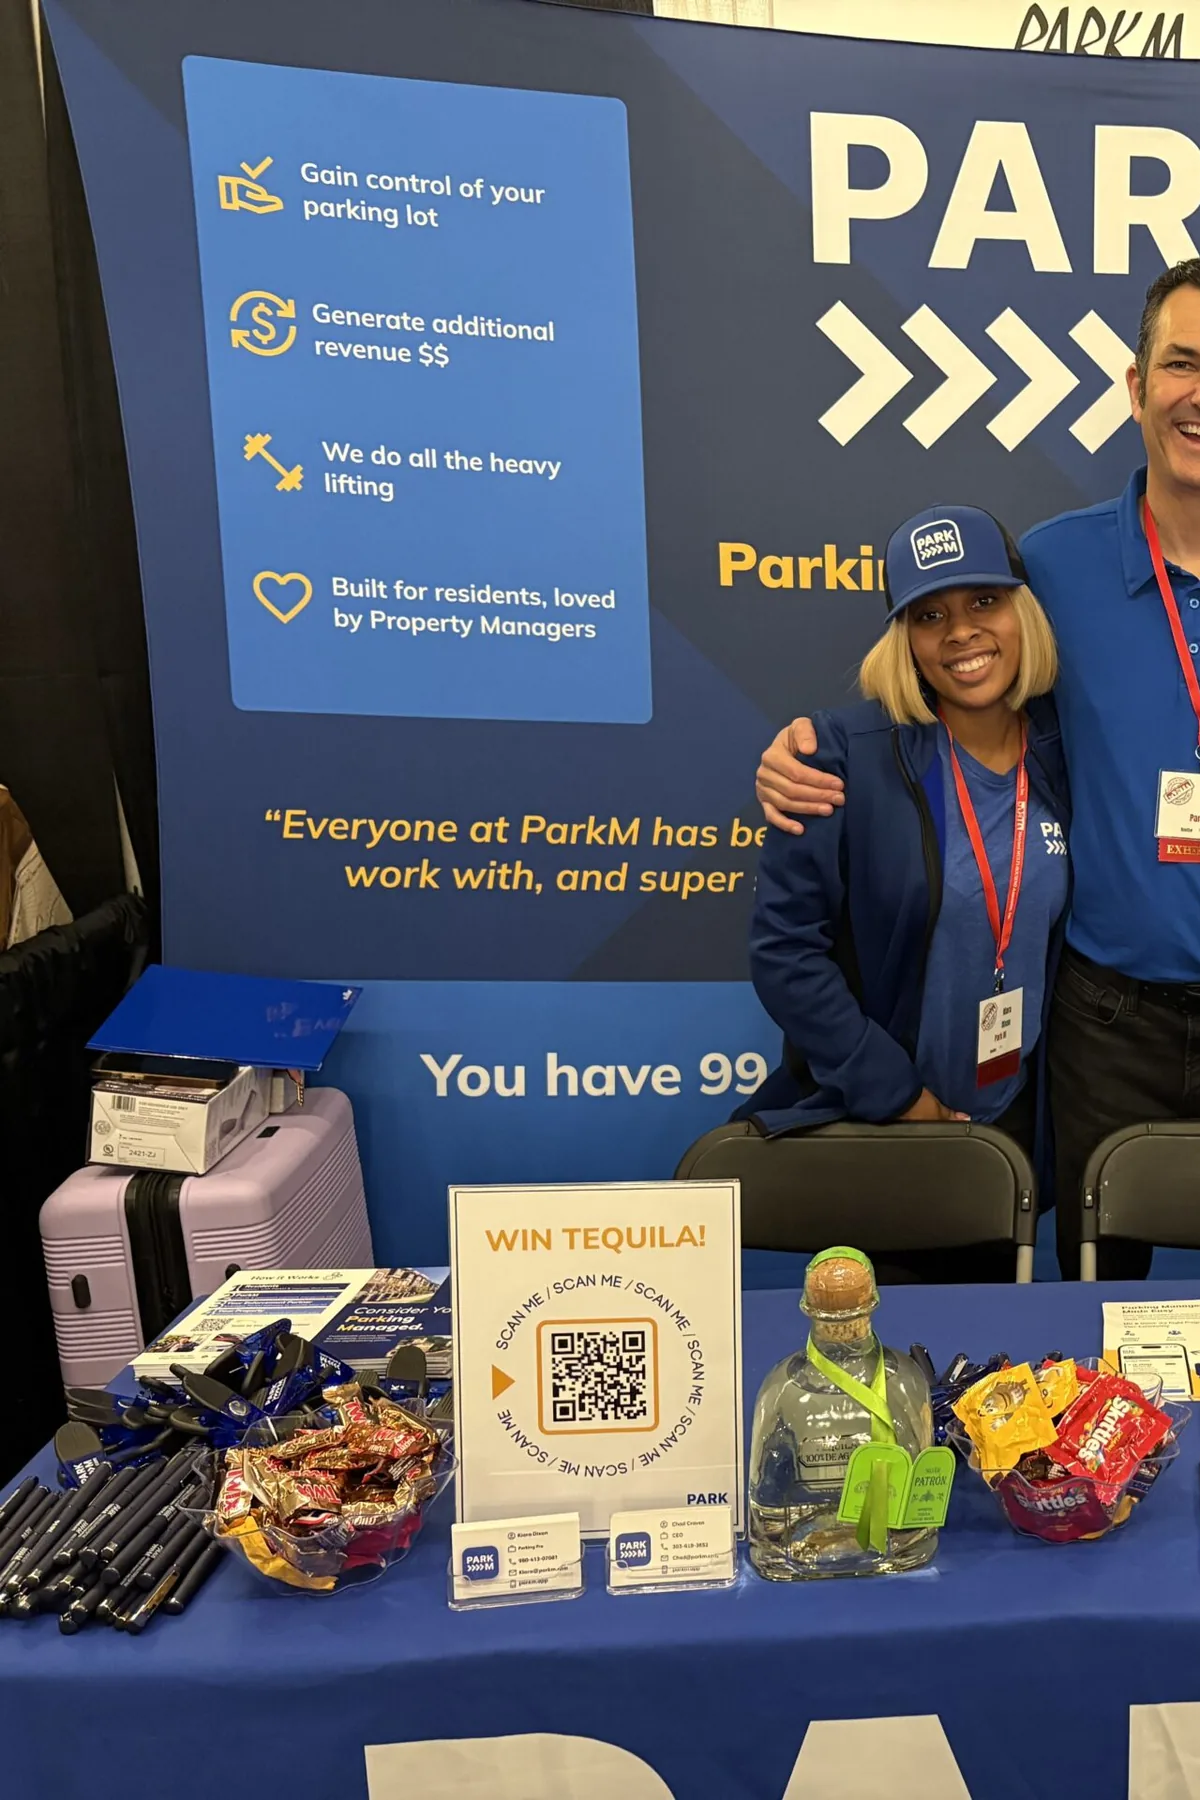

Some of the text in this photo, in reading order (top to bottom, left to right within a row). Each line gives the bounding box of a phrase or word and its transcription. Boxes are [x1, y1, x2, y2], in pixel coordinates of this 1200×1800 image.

[300, 162, 546, 206] Gain control of your
[303, 198, 439, 229] parking lot
[312, 303, 555, 342] Generate additional
[314, 340, 450, 369] revenue $$
[321, 441, 562, 481] We do all the heavy
[324, 472, 394, 503] lifting
[917, 530, 955, 550] PARK
[943, 542, 957, 552] M
[332, 576, 616, 609] Built for residents, loved
[333, 607, 597, 642] by Property Managers
[469, 816, 510, 844] at
[520, 815, 641, 846] ParkM
[652, 816, 718, 847] has
[344, 858, 744, 900] work with, and super
[419, 1052, 768, 1097] You have 99
[485, 1225, 705, 1254] WIN TEQUILA!
[337, 1323, 424, 1332] Managed.
[345, 1316, 415, 1324] Parking
[496, 1274, 704, 1477] SCAN ME SCAN ME SCAN ME SCAN ME SCAN ME SCAN ME SCAN ME
[687, 1492, 728, 1504] PARK
[466, 1554, 494, 1564] PARK
[620, 1540, 646, 1550] PARK
[638, 1548, 646, 1558] M
[484, 1562, 494, 1570] M
